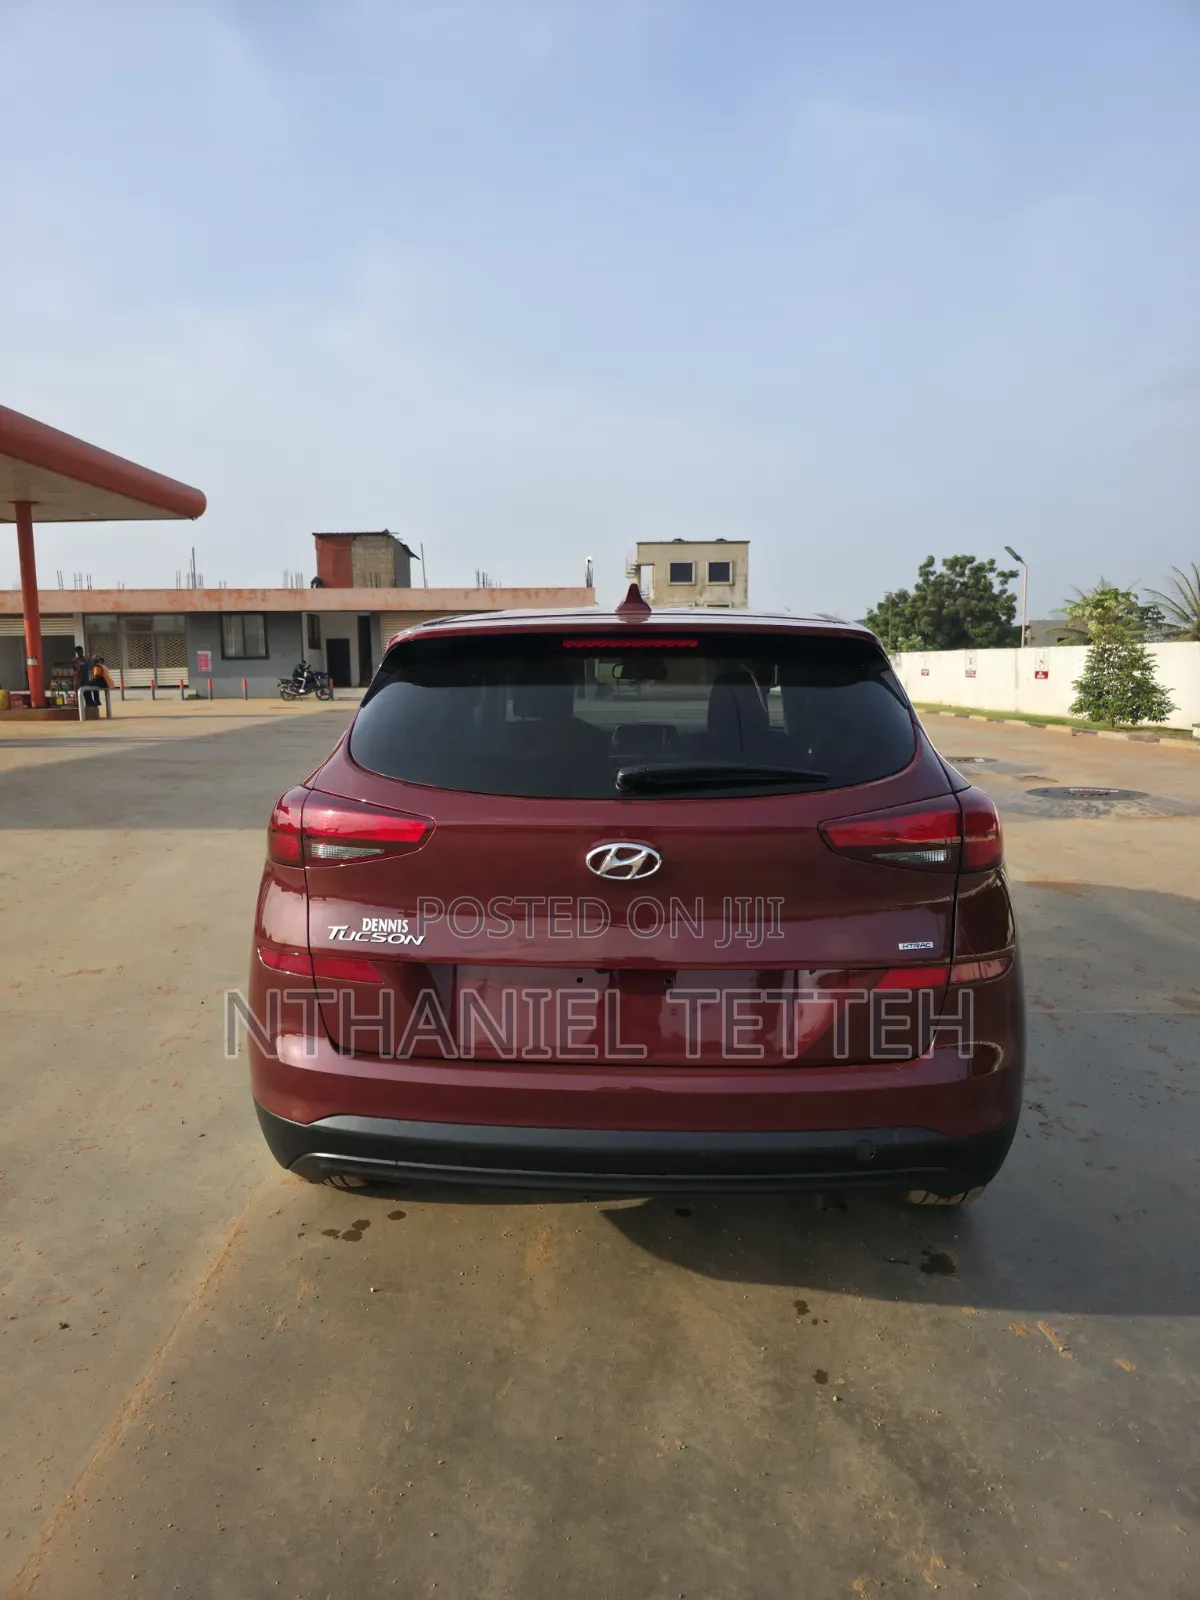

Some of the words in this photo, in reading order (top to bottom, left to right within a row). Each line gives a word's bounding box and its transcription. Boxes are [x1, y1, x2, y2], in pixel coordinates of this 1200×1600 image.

[362, 917, 409, 933] DENNIS
[328, 925, 425, 946] TUCSON
[901, 942, 933, 950] HTRAC
